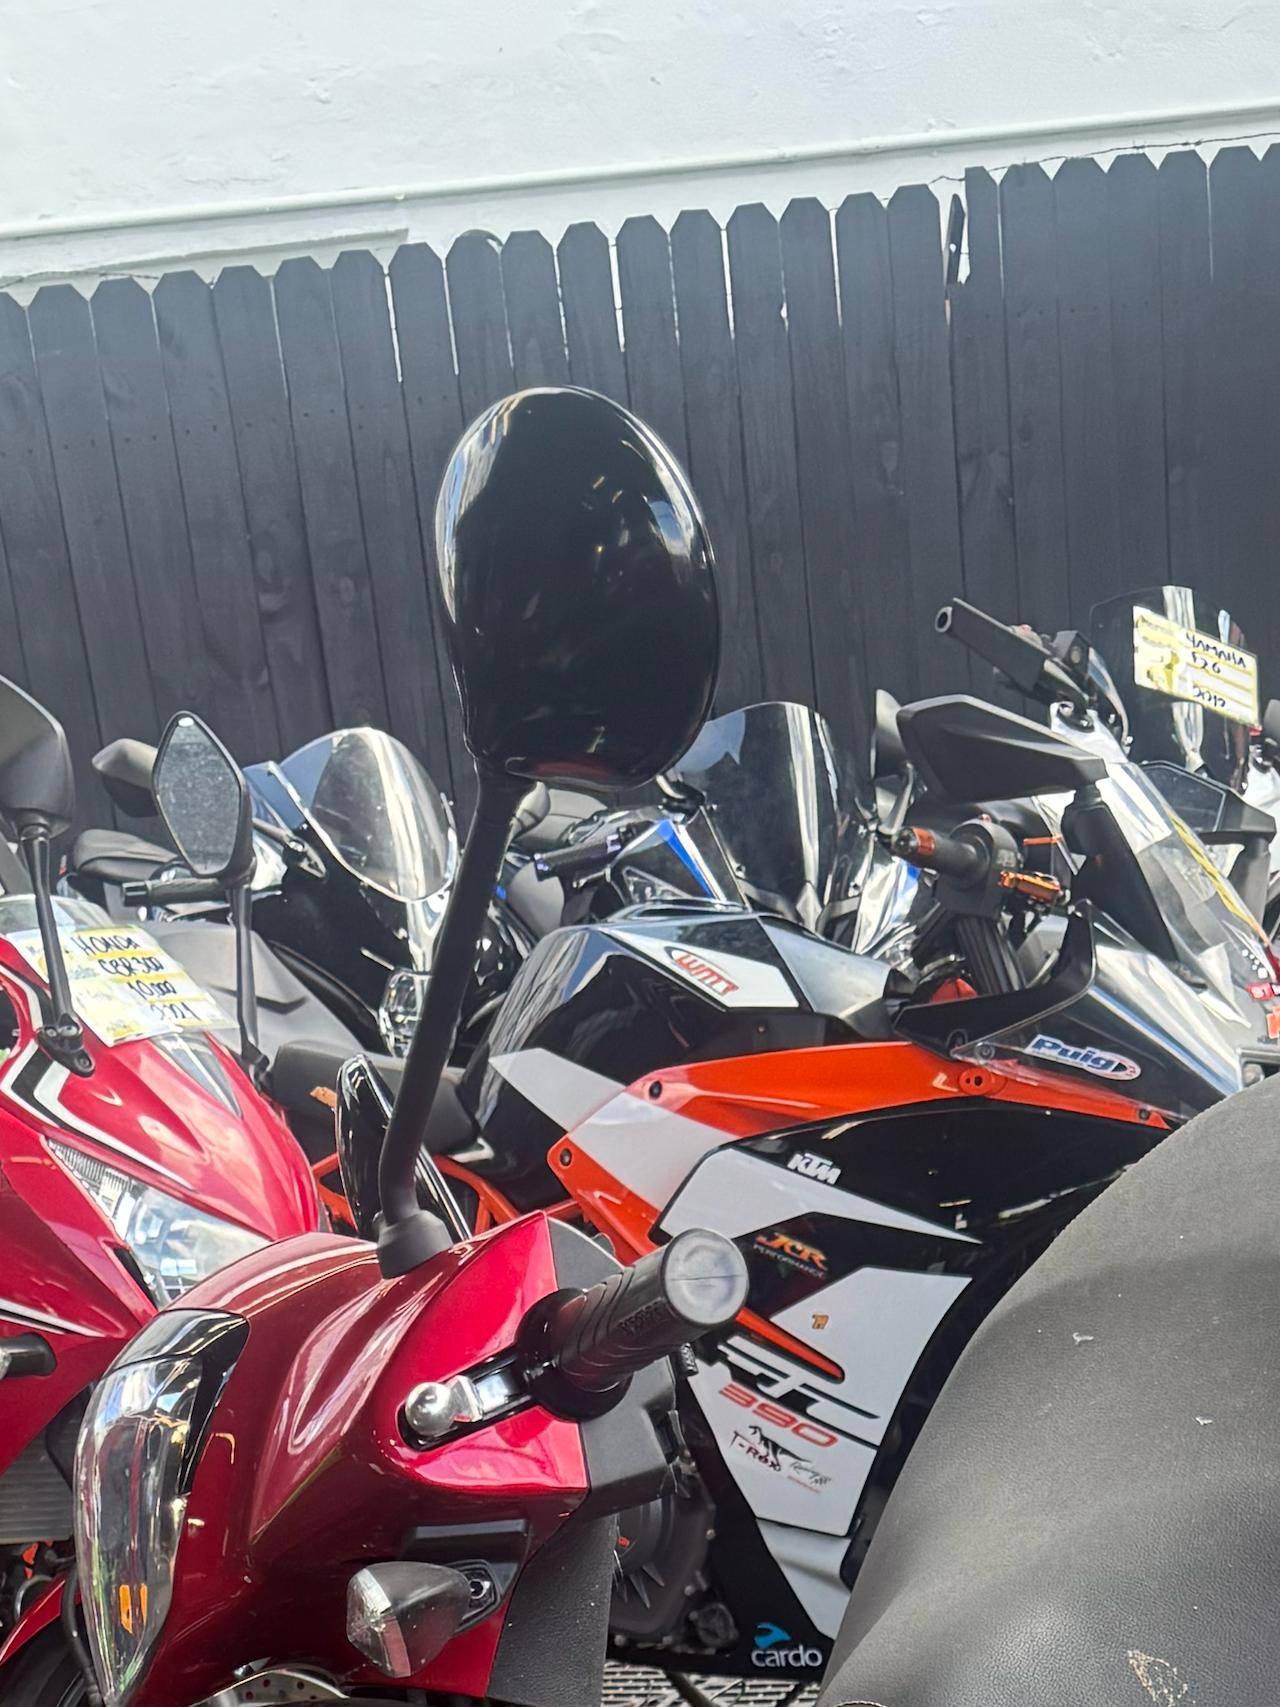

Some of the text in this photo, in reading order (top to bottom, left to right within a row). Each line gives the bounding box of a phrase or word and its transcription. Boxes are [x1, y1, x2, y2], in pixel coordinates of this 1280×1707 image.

[1186, 632, 1247, 668] YAMAHA
[70, 935, 141, 956] HONDA
[1031, 1038, 1118, 1071] Puig
[787, 1152, 842, 1186] KTM
[718, 1382, 839, 1448] 390
[751, 1644, 824, 1669] cardo
